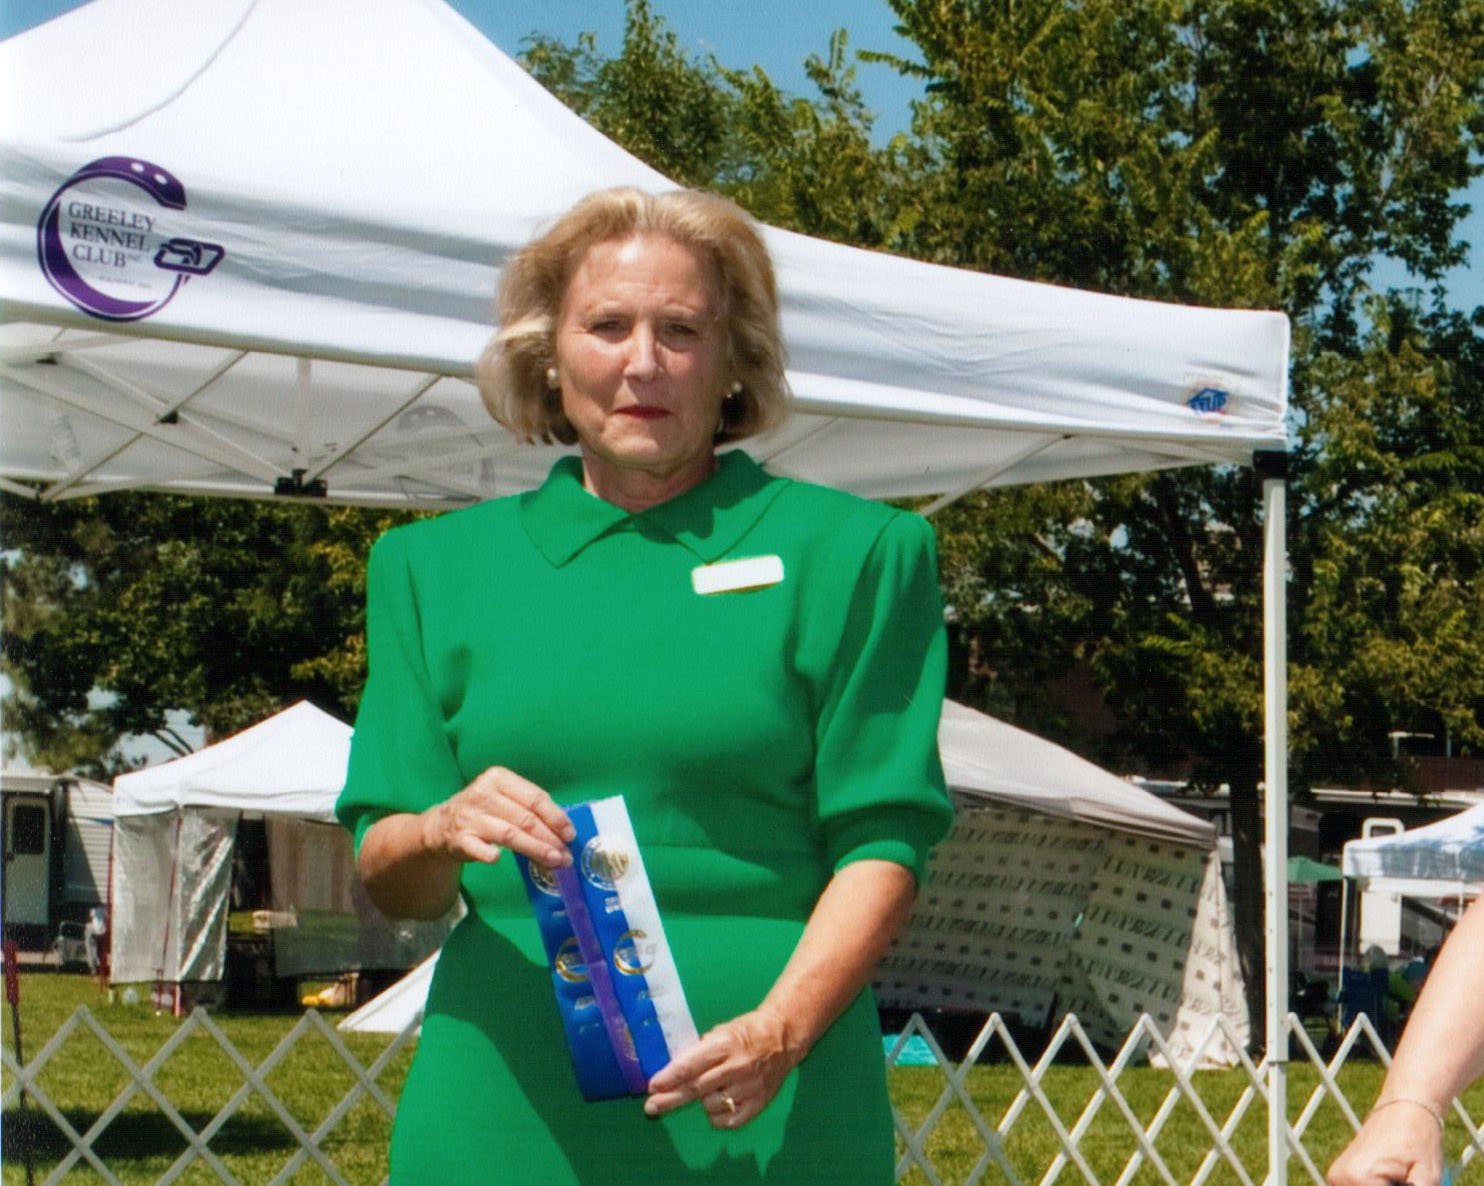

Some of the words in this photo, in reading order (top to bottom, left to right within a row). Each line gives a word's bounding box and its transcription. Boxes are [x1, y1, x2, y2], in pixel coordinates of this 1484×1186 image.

[69, 202, 156, 232] GREELEY
[70, 221, 151, 252] KENNEL
[73, 243, 127, 268] CLUB
